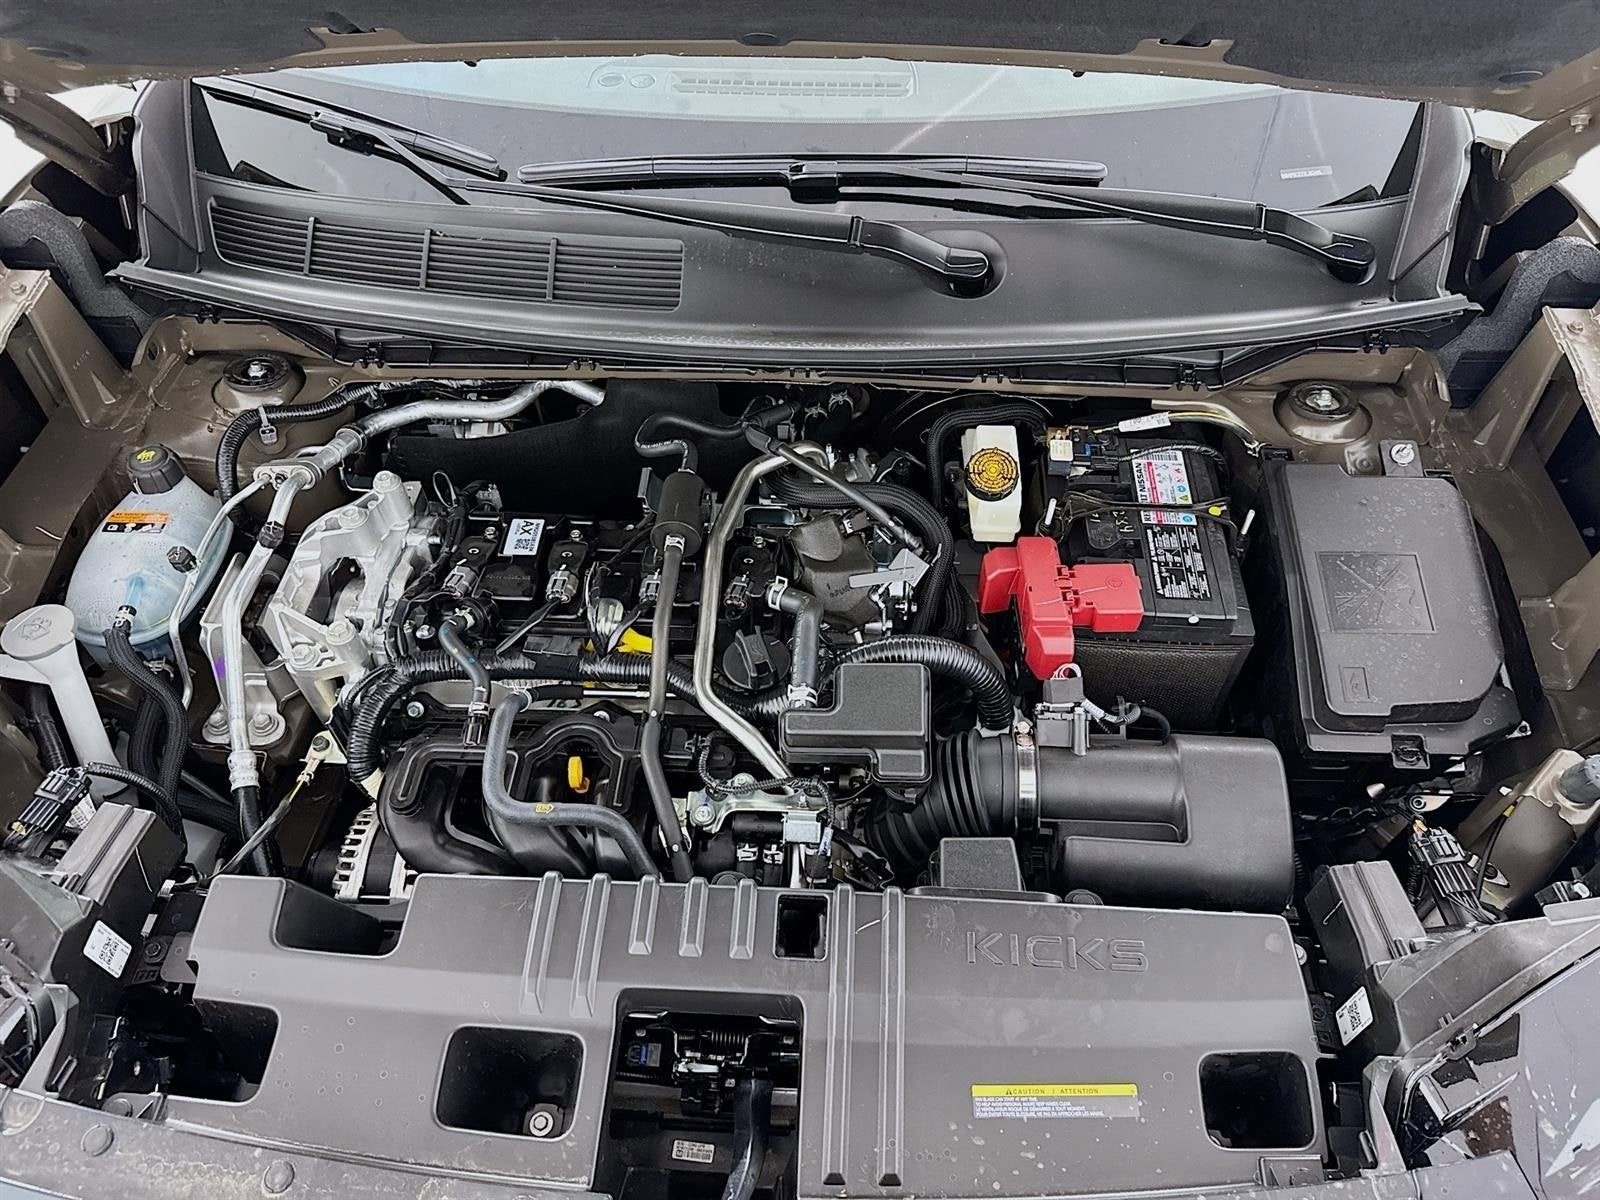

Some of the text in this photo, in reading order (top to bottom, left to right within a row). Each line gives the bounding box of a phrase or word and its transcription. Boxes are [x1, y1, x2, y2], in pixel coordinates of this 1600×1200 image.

[1135, 462, 1147, 493] NISSAN
[520, 520, 534, 535] AX
[966, 931, 1149, 972] KICKS
